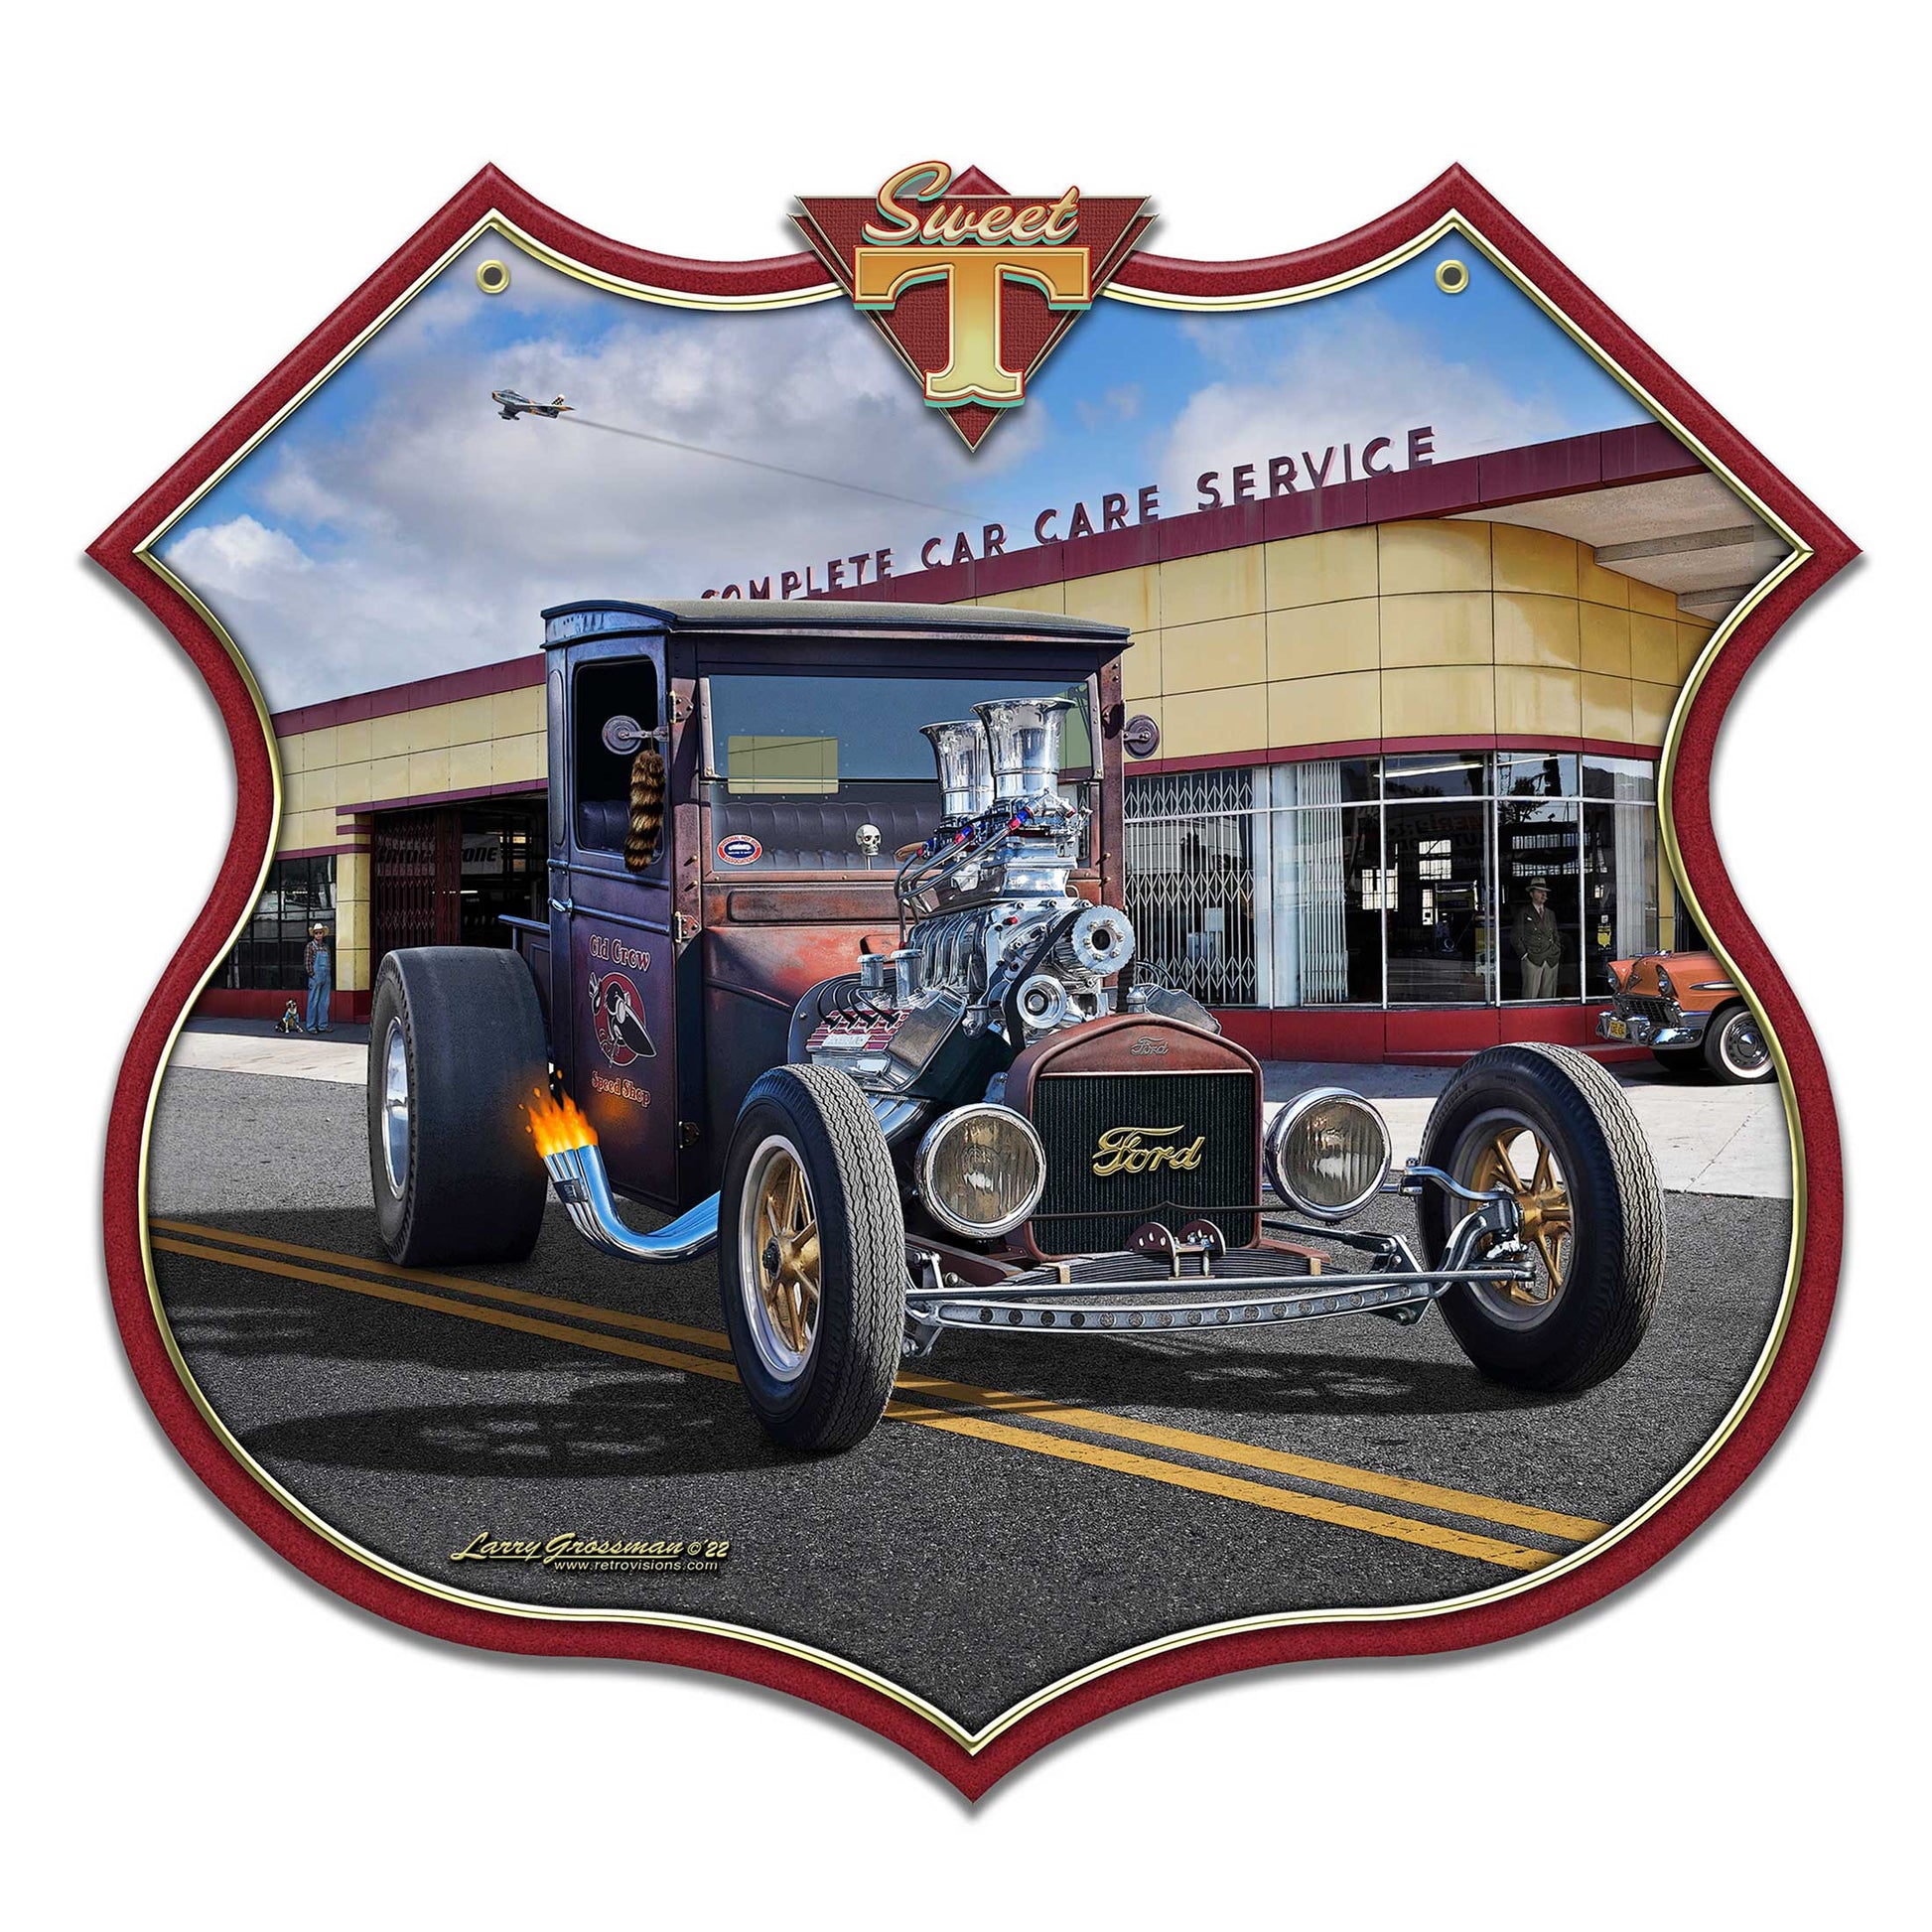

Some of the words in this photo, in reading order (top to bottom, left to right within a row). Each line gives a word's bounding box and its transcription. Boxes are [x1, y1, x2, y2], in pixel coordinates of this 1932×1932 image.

[862, 161, 1080, 245] Sweet
[853, 245, 1092, 408] T
[921, 523, 1007, 570] CAR
[1035, 484, 1161, 545] CARE
[1197, 426, 1436, 510] SERVICE
[589, 935, 610, 960] Old
[612, 938, 651, 972] Crow
[1130, 1035, 1170, 1055] Ford
[592, 1071, 621, 1098] Speed
[621, 1078, 651, 1108] Shop
[1092, 1125, 1205, 1176] Ford
